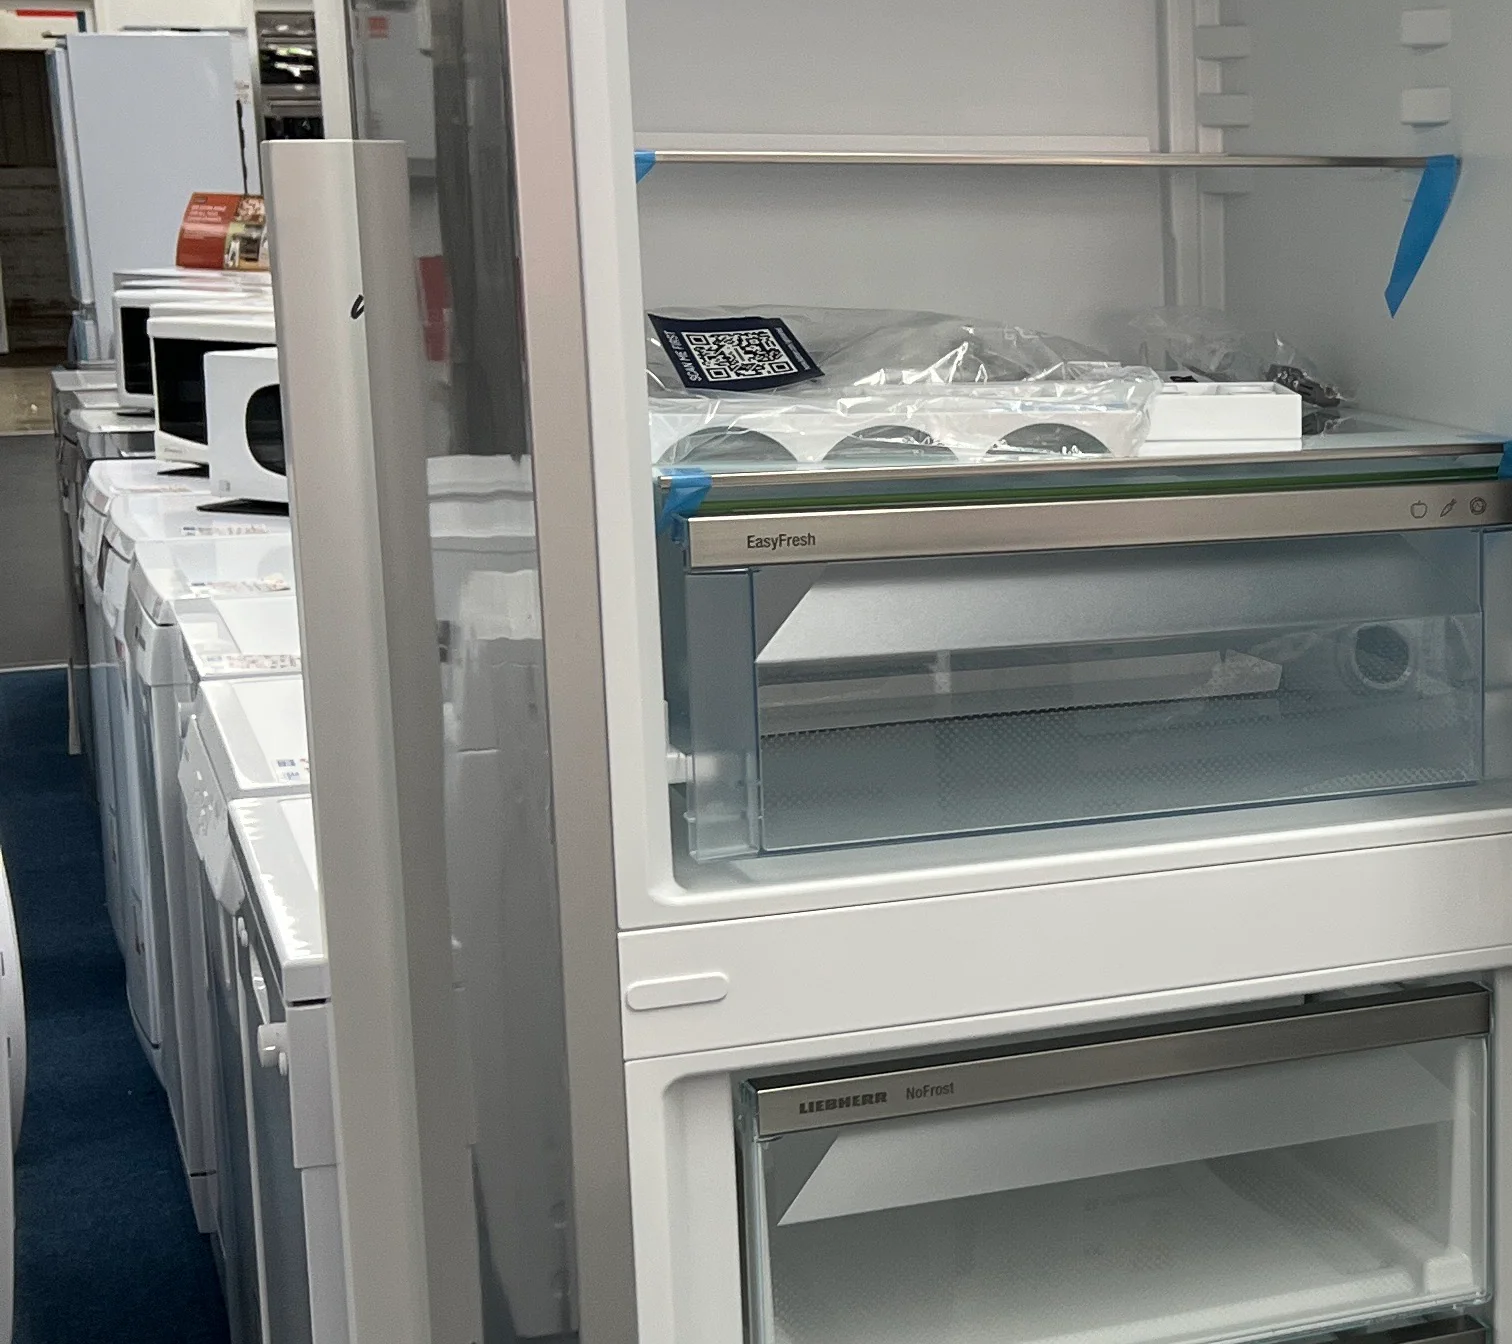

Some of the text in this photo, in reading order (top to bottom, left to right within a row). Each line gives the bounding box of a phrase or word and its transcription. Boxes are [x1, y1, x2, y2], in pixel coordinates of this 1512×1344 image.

[747, 532, 816, 551] EasyFresh
[799, 1082, 955, 1115] LIEBHERR NoFrost
